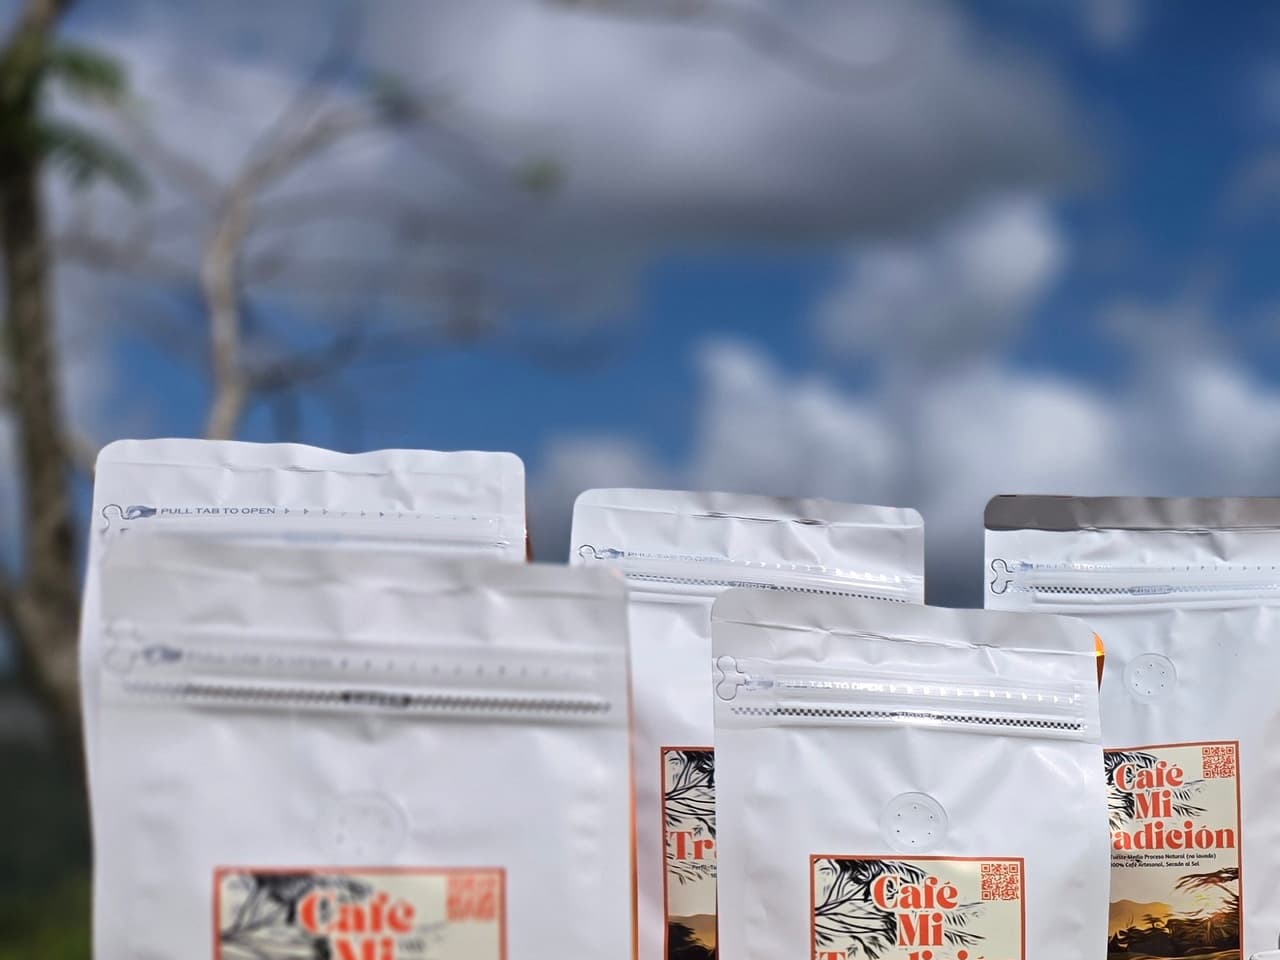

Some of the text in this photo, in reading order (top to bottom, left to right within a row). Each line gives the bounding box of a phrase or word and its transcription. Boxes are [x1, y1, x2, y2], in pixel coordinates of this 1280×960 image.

[160, 507, 276, 515] PULL TAB TO OPEN
[1115, 760, 1184, 792] Café
[1135, 789, 1172, 820] Mi
[669, 831, 717, 860] Tr
[1110, 820, 1235, 851] adición
[873, 875, 958, 910] Café
[898, 912, 944, 947] Mi
